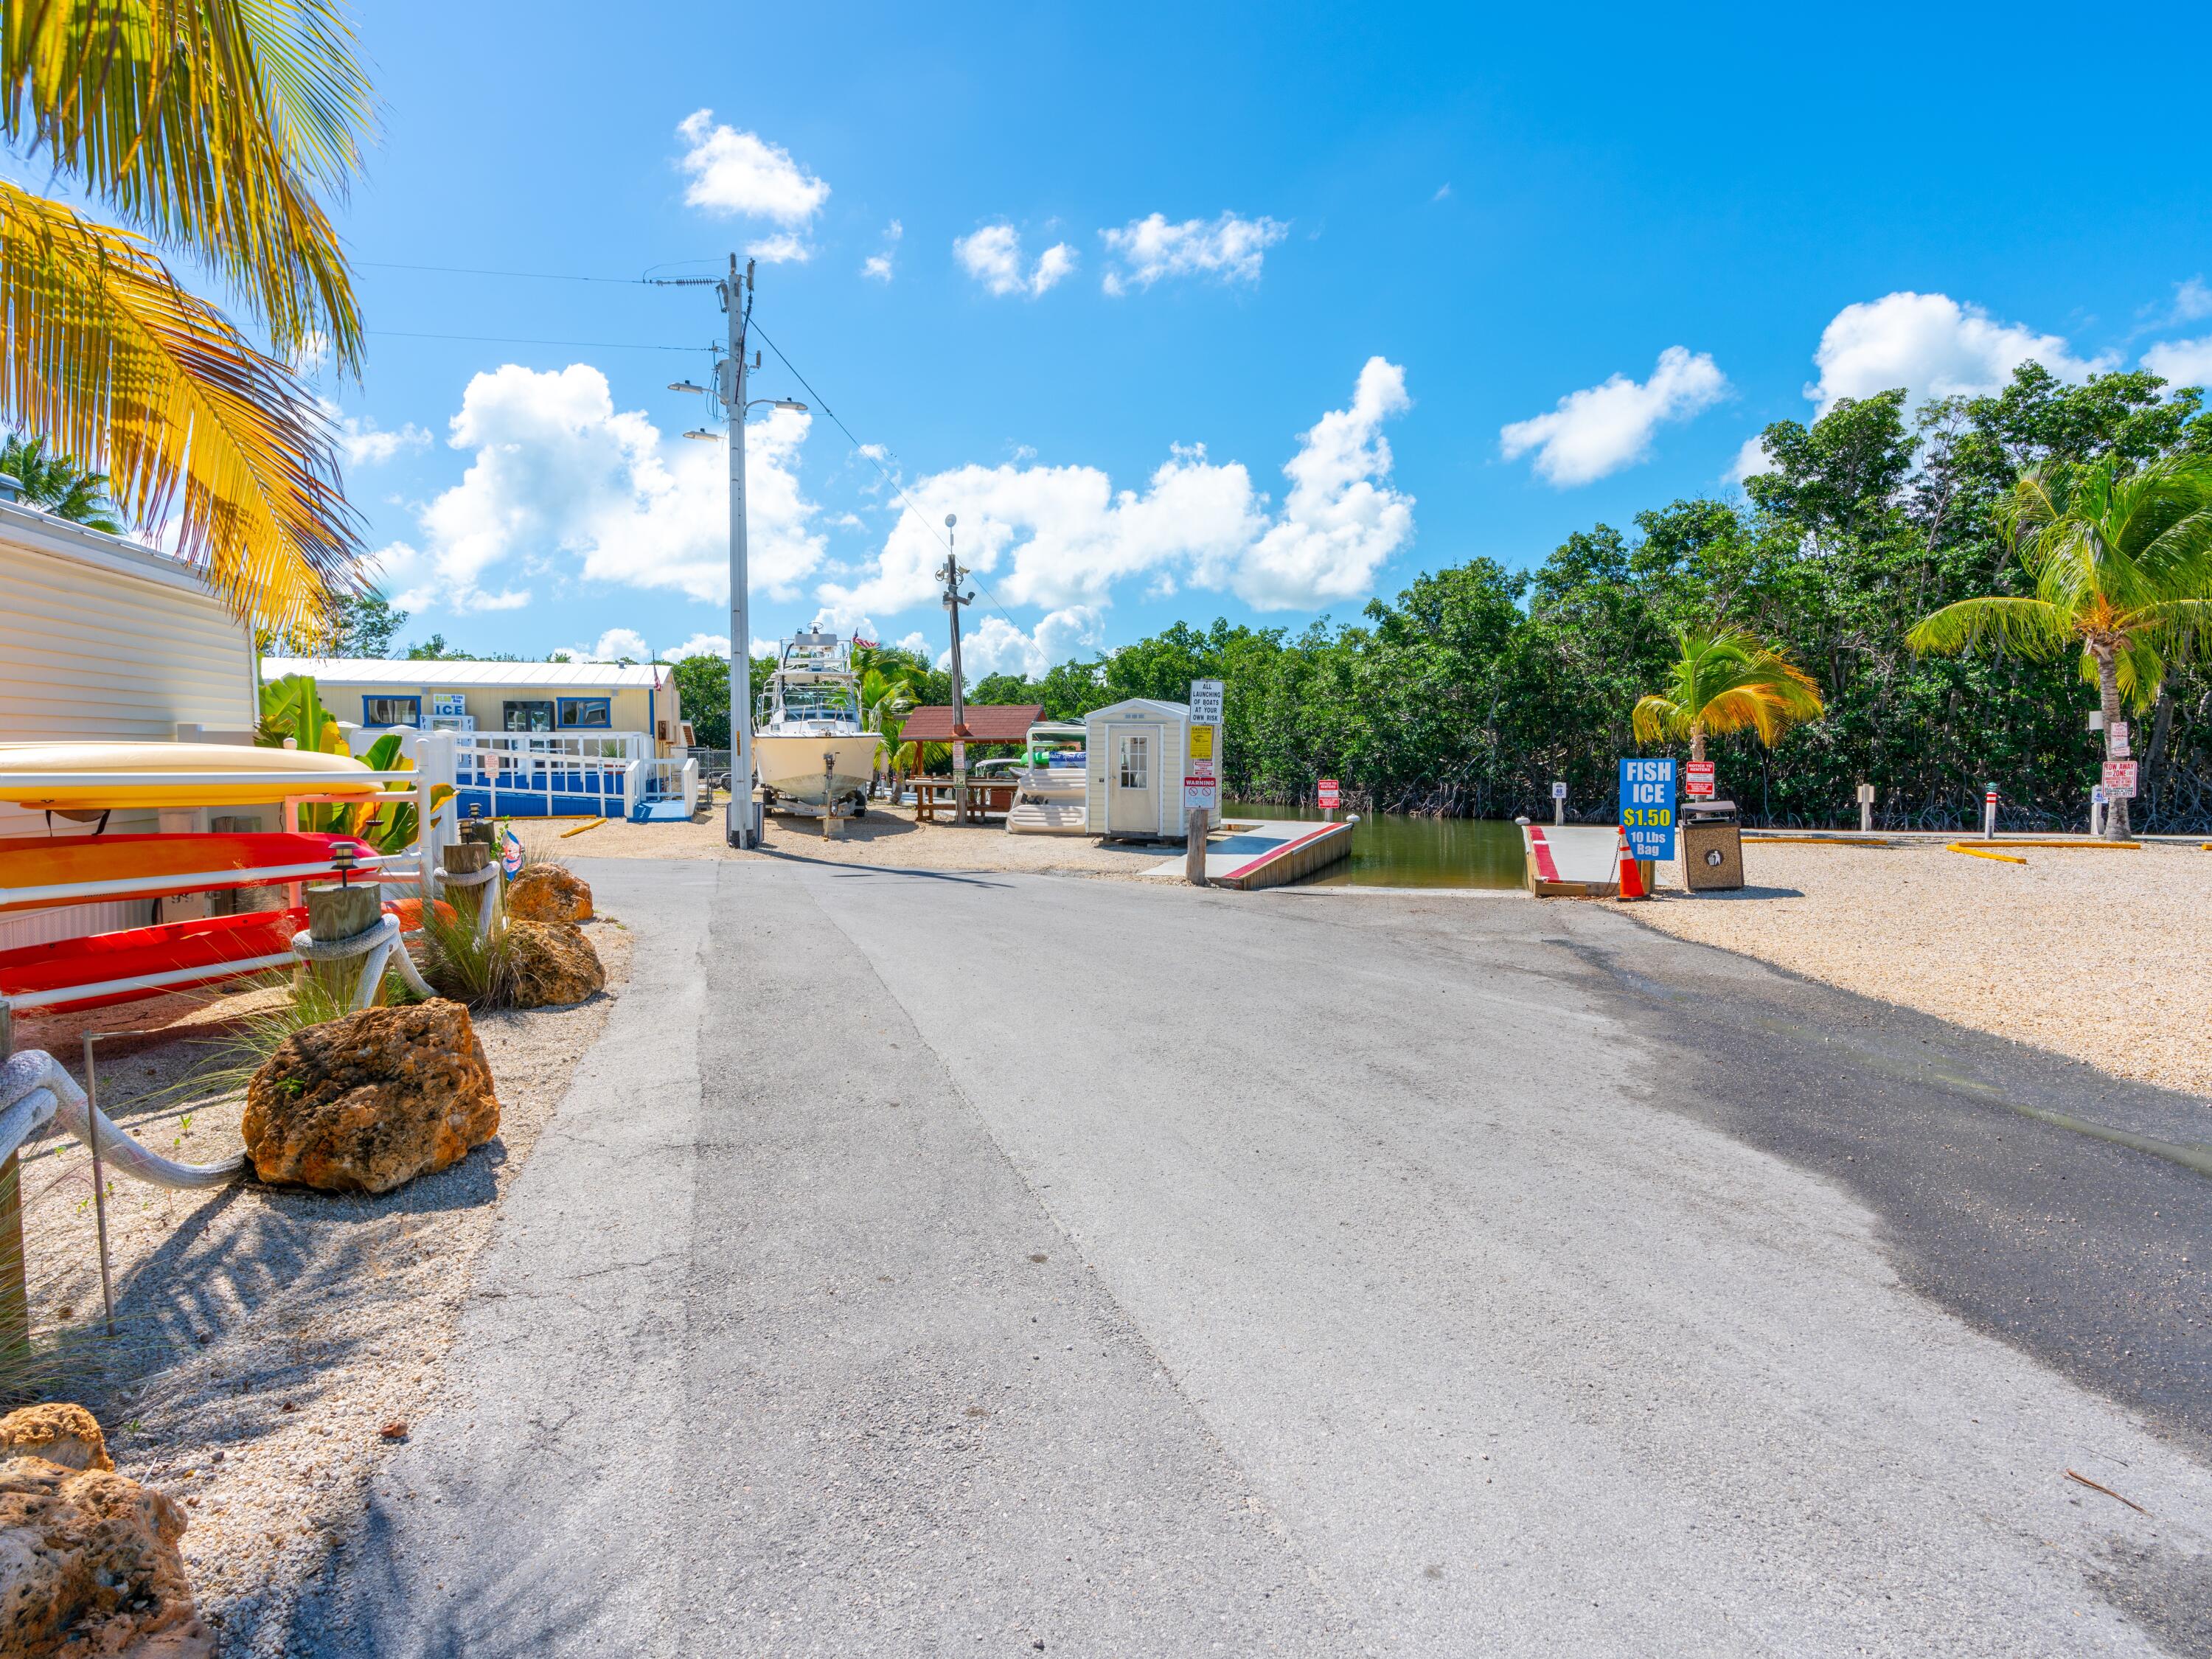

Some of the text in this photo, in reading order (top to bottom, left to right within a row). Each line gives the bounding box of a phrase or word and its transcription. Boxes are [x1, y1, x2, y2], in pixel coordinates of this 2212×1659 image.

[436, 705, 462, 715] ICE
[1627, 762, 1671, 782] FISH
[1632, 784, 1665, 804] ICE
[1624, 807, 1671, 827] $1.50
[1631, 831, 1666, 844] 10 Lbs
[1637, 844, 1660, 857] Bag
